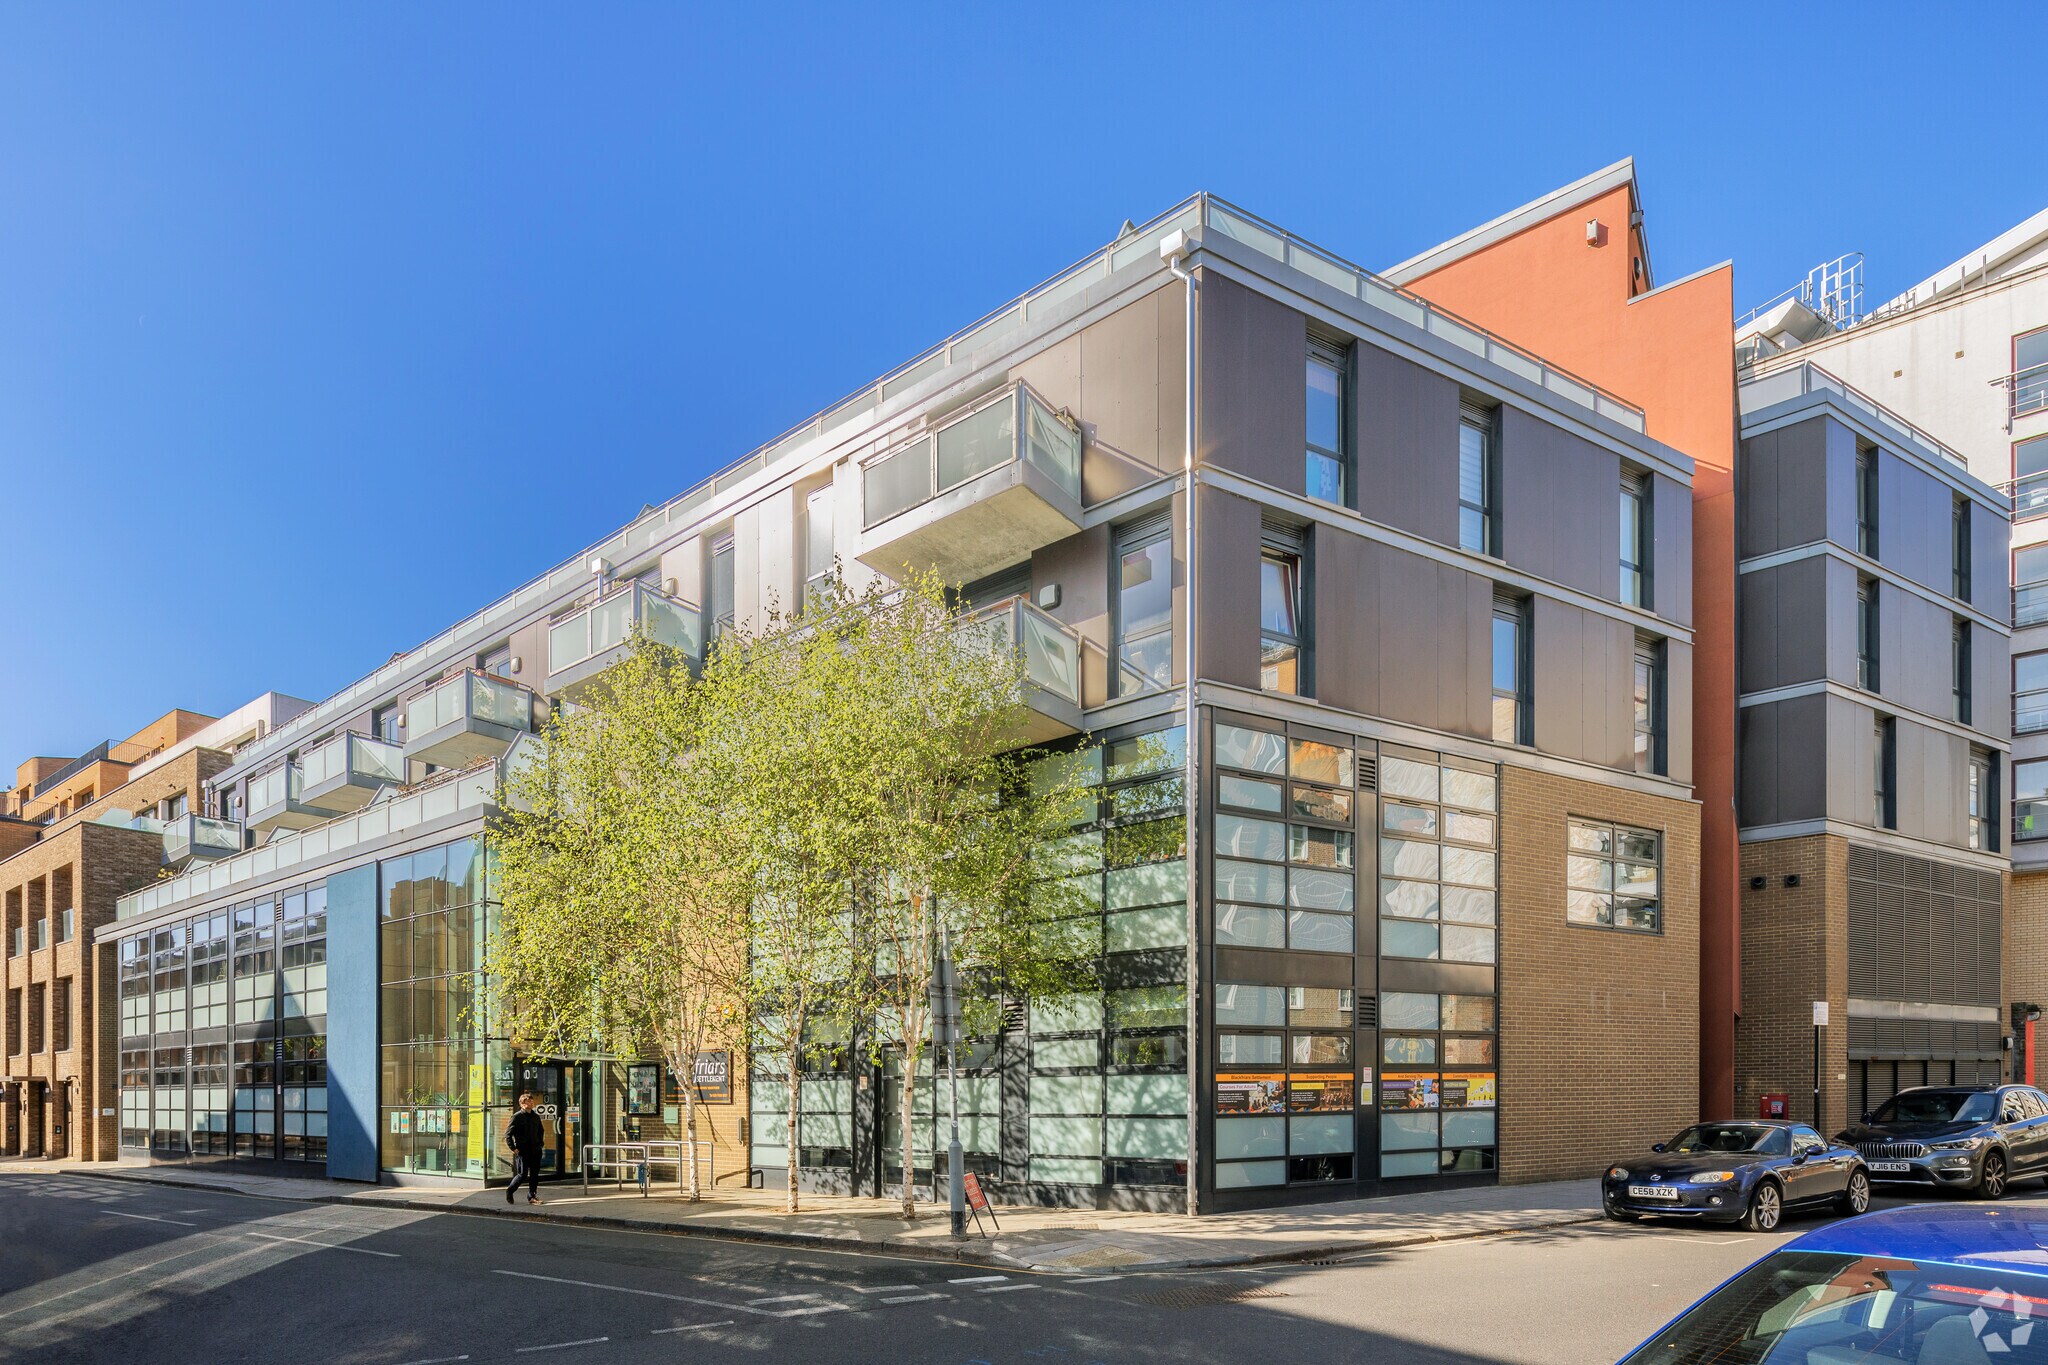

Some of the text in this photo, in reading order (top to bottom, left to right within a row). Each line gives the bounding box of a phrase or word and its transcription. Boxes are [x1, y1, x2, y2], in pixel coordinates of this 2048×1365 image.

[696, 1075, 725, 1083] SETTLEMENT
[1890, 1163, 1907, 1171] ENS
[1632, 1187, 1673, 1197] CE58 XZK
